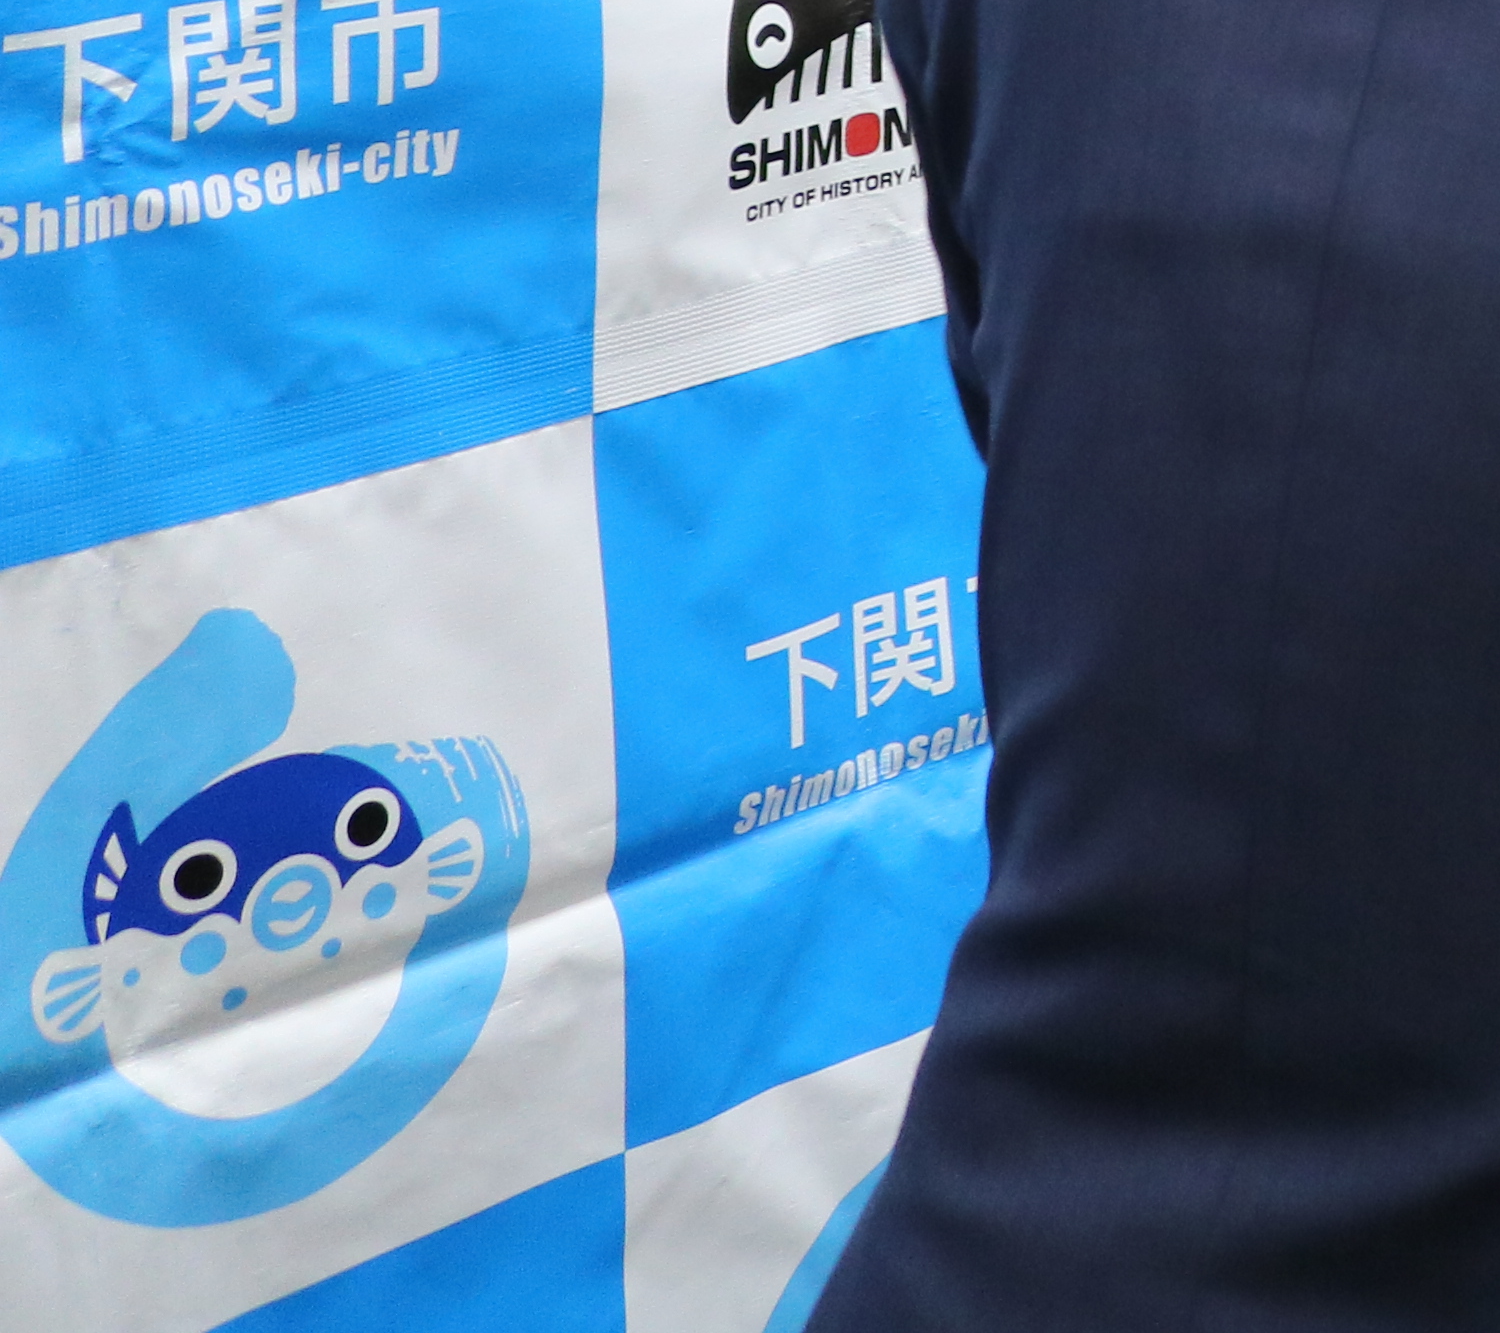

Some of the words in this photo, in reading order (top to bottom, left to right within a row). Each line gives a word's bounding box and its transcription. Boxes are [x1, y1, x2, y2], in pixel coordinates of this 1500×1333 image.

[0, 128, 460, 260] Shimonoseki-city
[729, 107, 912, 191] SHIMON
[746, 195, 787, 222] CITY
[792, 188, 816, 209] OF
[821, 170, 905, 202] HISTORY
[745, 576, 979, 750] 下関
[733, 707, 989, 836] Shimonoseki
